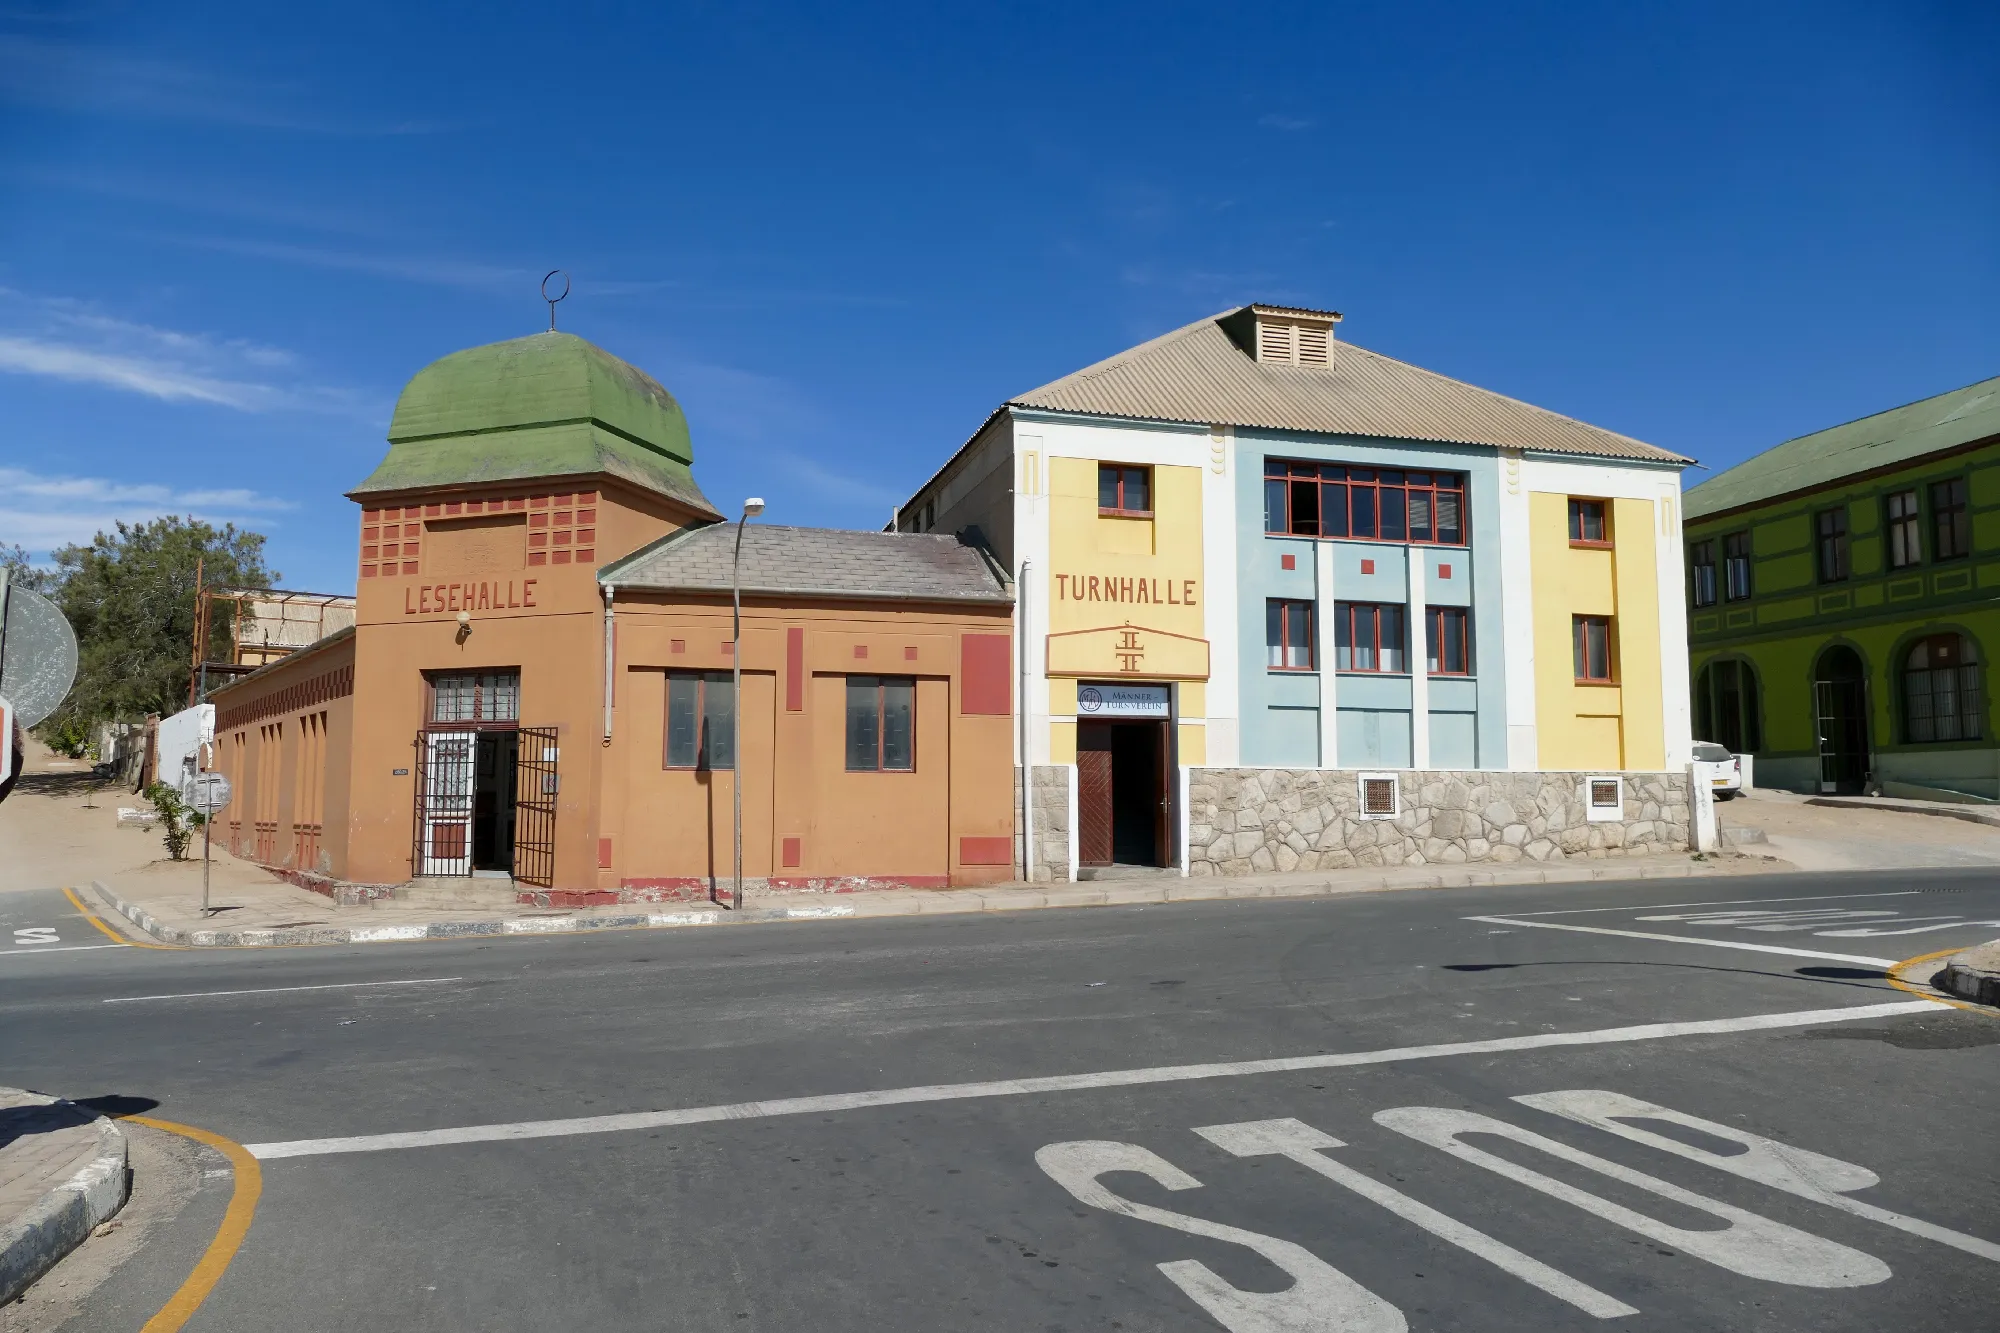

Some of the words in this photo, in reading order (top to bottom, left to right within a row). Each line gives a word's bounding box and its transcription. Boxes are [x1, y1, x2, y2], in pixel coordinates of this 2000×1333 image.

[405, 579, 537, 614] LESEHALLE
[1055, 573, 1197, 606] TURNHALLE
[1034, 1090, 2000, 1333] STOP
